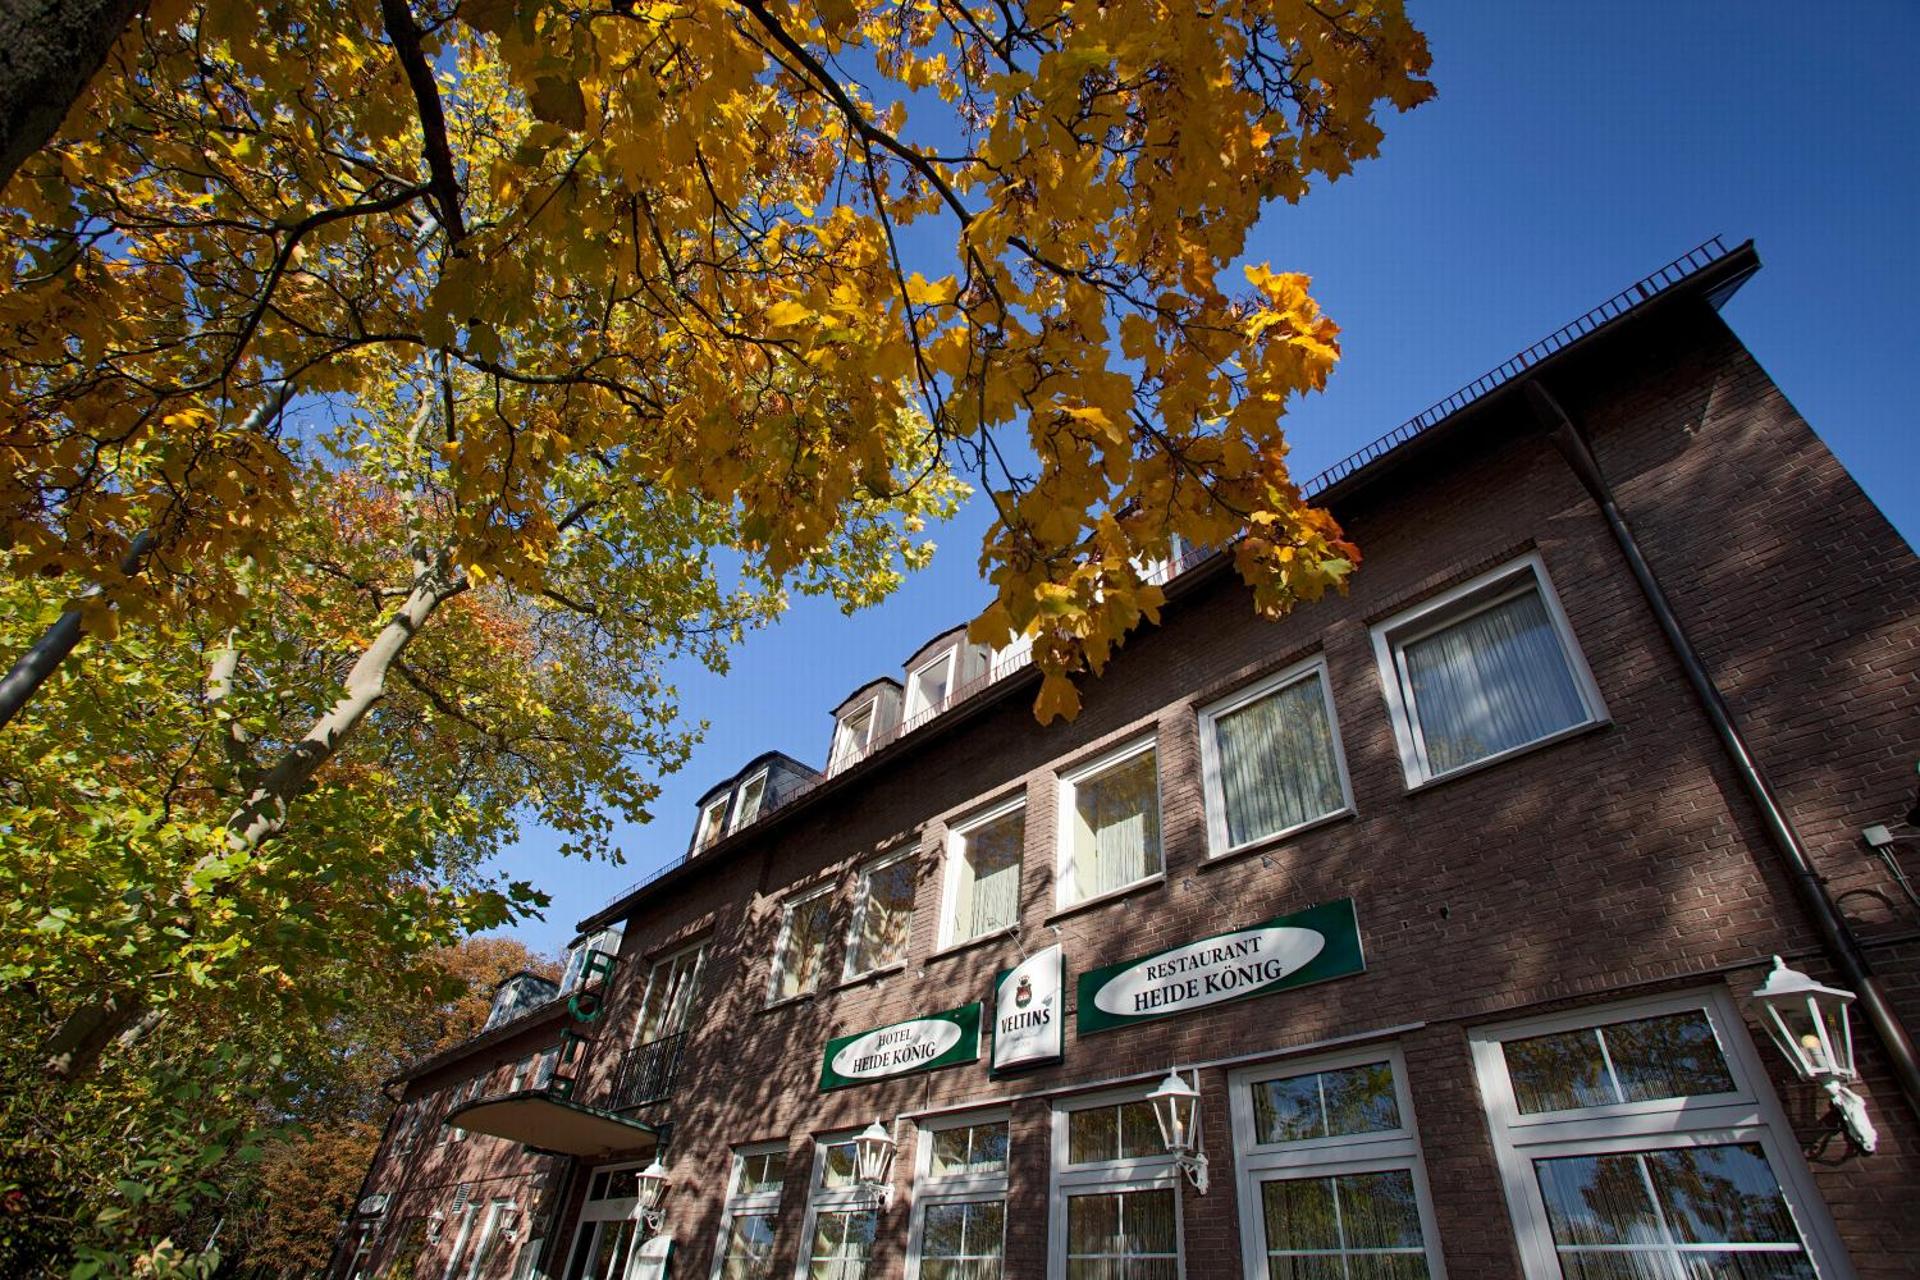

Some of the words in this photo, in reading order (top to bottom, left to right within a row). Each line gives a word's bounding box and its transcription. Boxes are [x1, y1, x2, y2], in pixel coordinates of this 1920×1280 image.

[1147, 937, 1262, 981] RESTAURANT
[1133, 978, 1200, 1012] HEIDE
[1205, 958, 1283, 995] KÖNIG
[878, 1028, 912, 1047] HOTEL
[1001, 1008, 1050, 1034] VELTINS
[852, 1051, 891, 1074] HEIDE
[892, 1041, 936, 1064] KÖNIG
